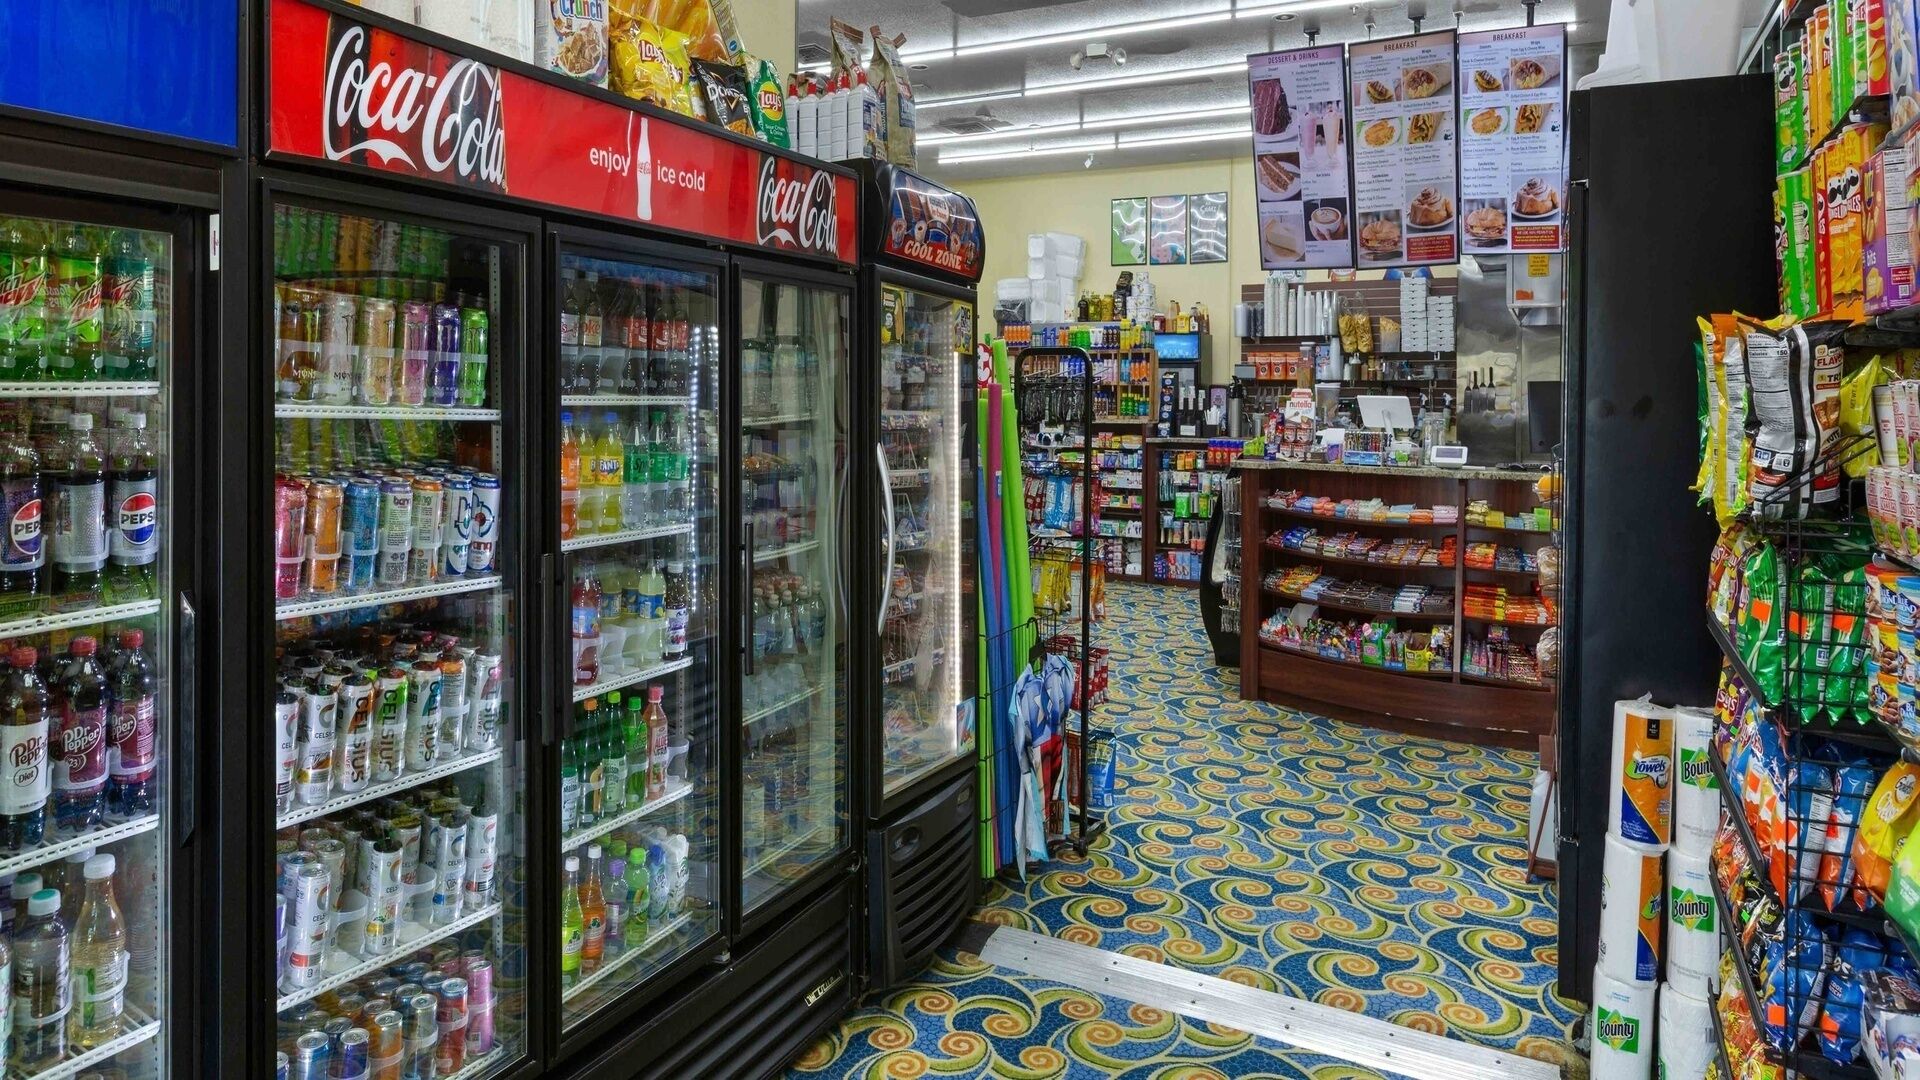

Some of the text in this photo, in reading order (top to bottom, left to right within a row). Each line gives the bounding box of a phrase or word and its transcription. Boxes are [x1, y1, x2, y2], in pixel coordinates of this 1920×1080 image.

[560, 0, 604, 21] Crunch
[1493, 31, 1527, 41] BREAKFAST
[1383, 40, 1418, 52] BREAKFAST
[1268, 54, 1291, 64] DESSERT
[1298, 52, 1319, 60] DRINKS
[324, 26, 508, 186] Coca-Cola
[590, 146, 630, 177] enjoy
[657, 160, 676, 185] ice
[678, 169, 706, 192] cold
[757, 156, 839, 256] Coca-Cola
[903, 240, 963, 270] COOL ZONE
[1776, 348, 1788, 356] 150
[1289, 400, 1312, 409] nutella
[121, 512, 154, 524] PEPS
[14, 523, 41, 536] PEP
[62, 727, 100, 753] Pepper
[351, 696, 371, 783] CELSIUS
[1633, 759, 1665, 774] Towels
[18, 770, 34, 783] Diet
[1672, 900, 1709, 918] Bounty
[1600, 1021, 1634, 1038] Bounty
